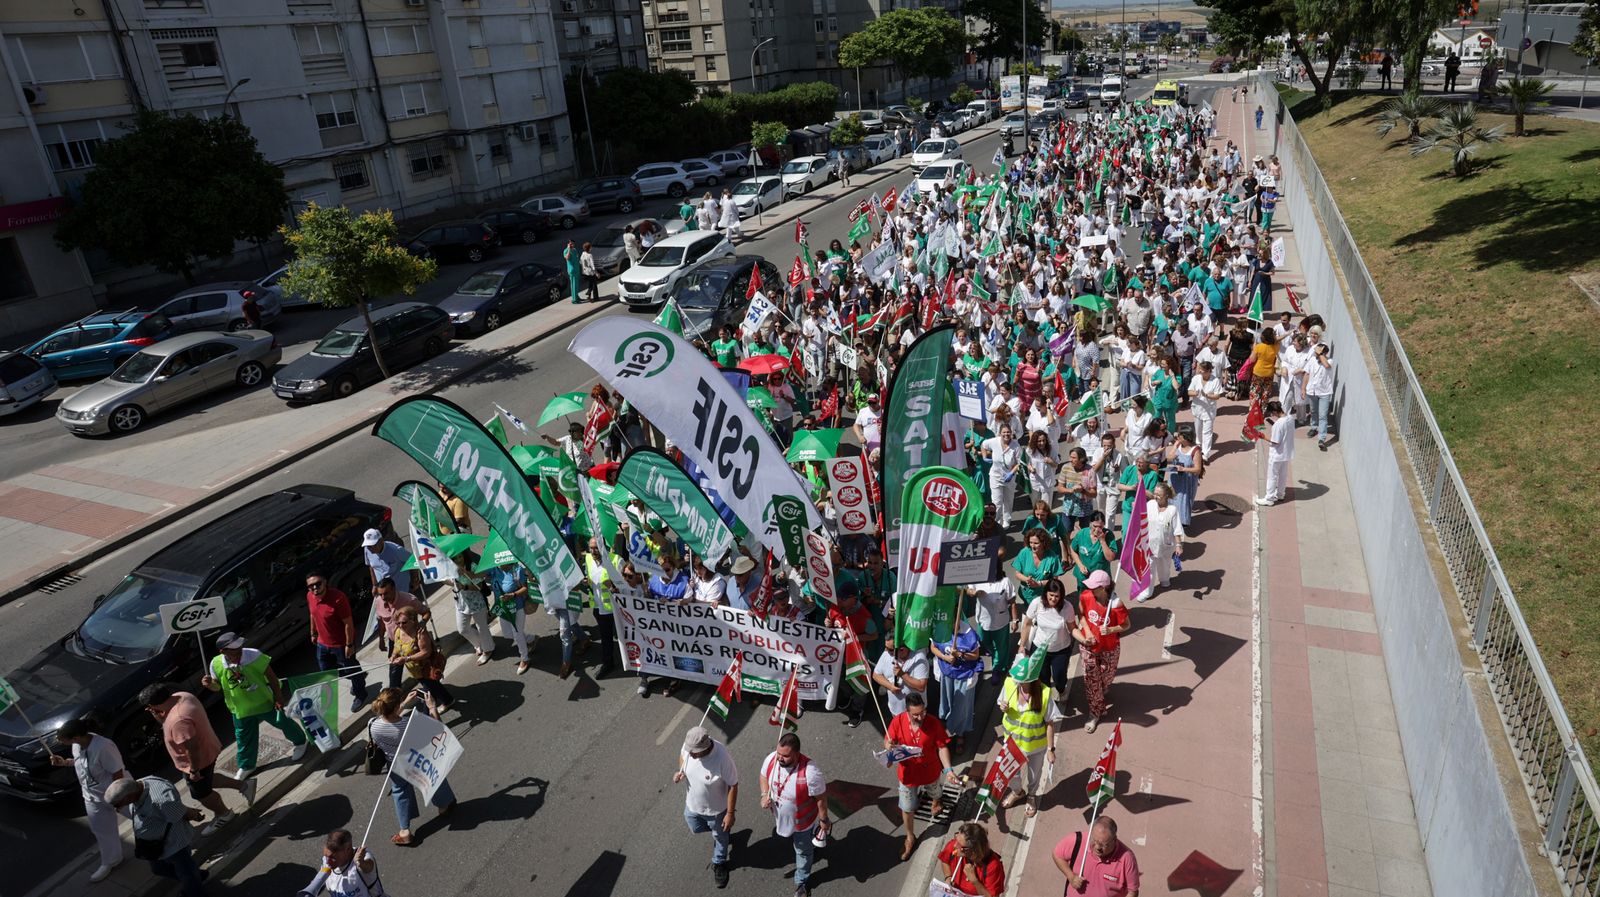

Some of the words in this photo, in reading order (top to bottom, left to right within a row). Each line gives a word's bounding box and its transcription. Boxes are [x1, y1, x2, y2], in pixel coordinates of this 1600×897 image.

[908, 379, 935, 389] SATSE
[928, 481, 963, 504] UGT
[783, 506, 803, 517] CSIF
[179, 608, 215, 622] CSI-F
[633, 598, 717, 620] DEFENSA
[723, 610, 745, 625] DE
[751, 615, 842, 643] NUESTRA
[638, 618, 723, 638] SANIDAD
[728, 629, 807, 657] PÚBLICA
[641, 632, 665, 649] NO
[671, 639, 714, 657] MÁS
[743, 678, 778, 692] SATSE
